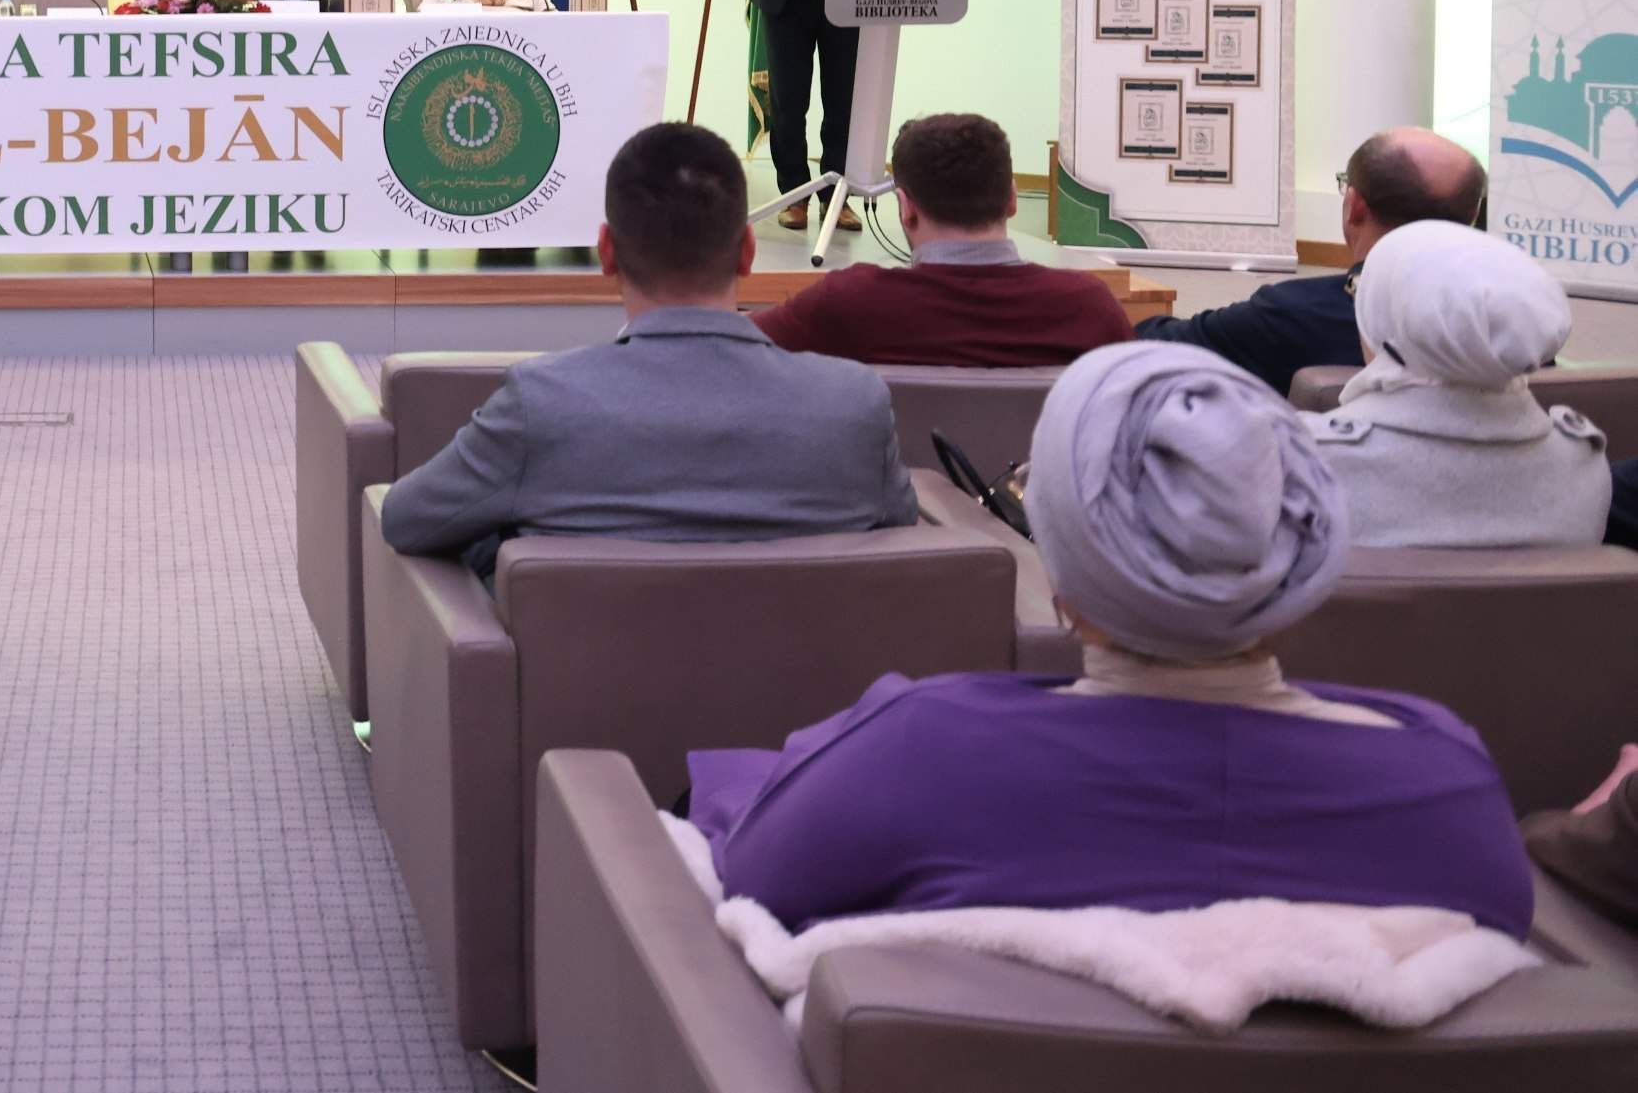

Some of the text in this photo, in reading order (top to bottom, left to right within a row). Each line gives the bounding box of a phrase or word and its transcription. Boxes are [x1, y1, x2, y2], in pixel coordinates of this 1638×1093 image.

[855, 6, 938, 18] BIBLIOTEKA
[59, 30, 351, 79] TEFSIRA
[366, 25, 578, 120] ISLAMSKA ZAJEDNICA U BiH
[130, 192, 350, 236] JEZIKU
[377, 170, 466, 235] TARIKATSKI
[471, 197, 544, 235] CENTAR
[539, 169, 567, 201] BiH
[1504, 212, 1552, 232] GAZI
[1506, 233, 1638, 267] BIBLIO
